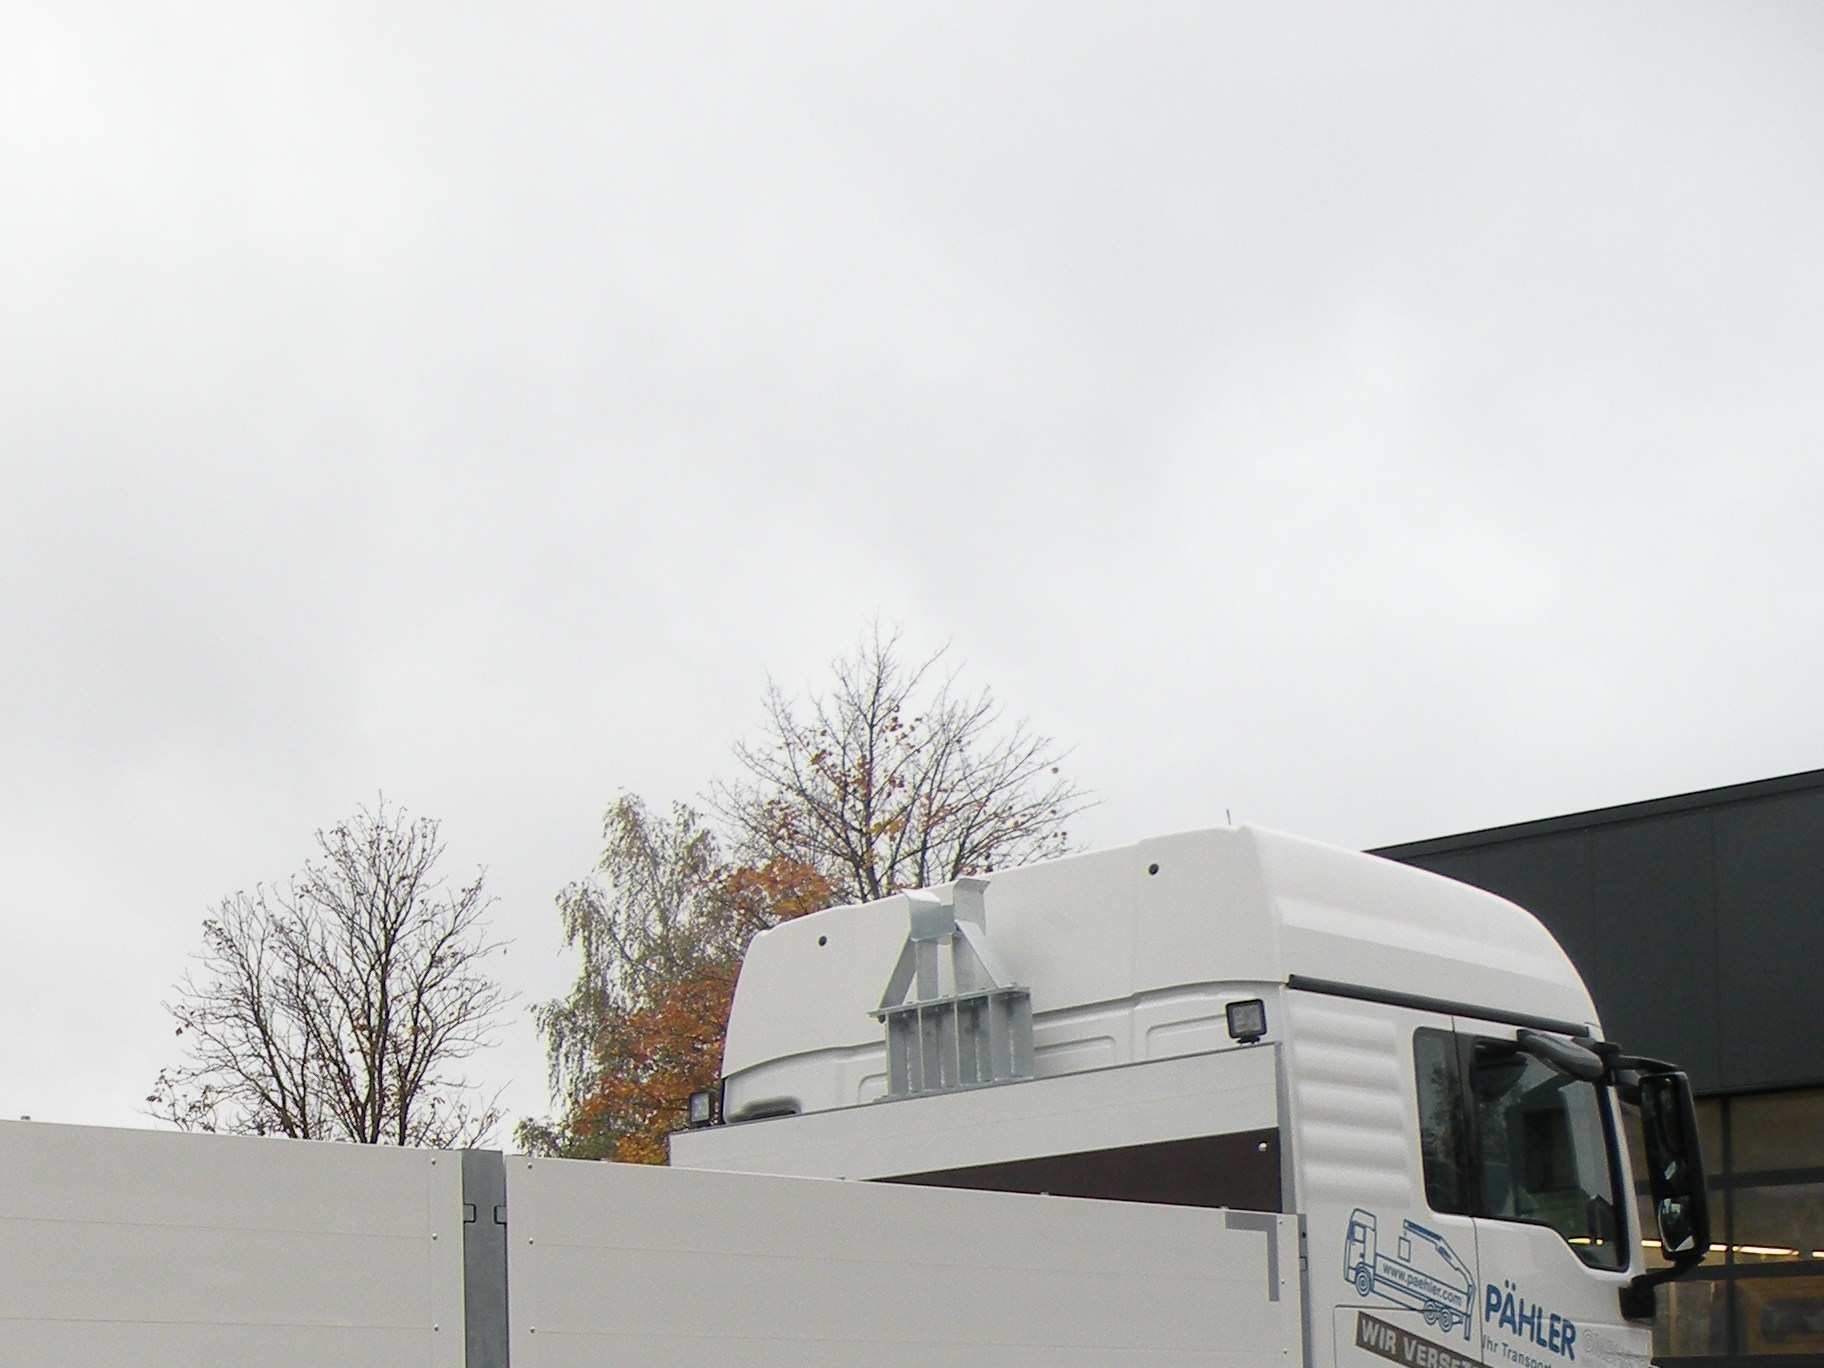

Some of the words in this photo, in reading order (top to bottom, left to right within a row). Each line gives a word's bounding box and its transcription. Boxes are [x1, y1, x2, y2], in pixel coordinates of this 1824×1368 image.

[1382, 1263, 1462, 1306] www.paehler.com
[1361, 1319, 1396, 1355] WIR
[1484, 1279, 1576, 1361] PÄHLER
[1482, 1334, 1498, 1353] Ihr
